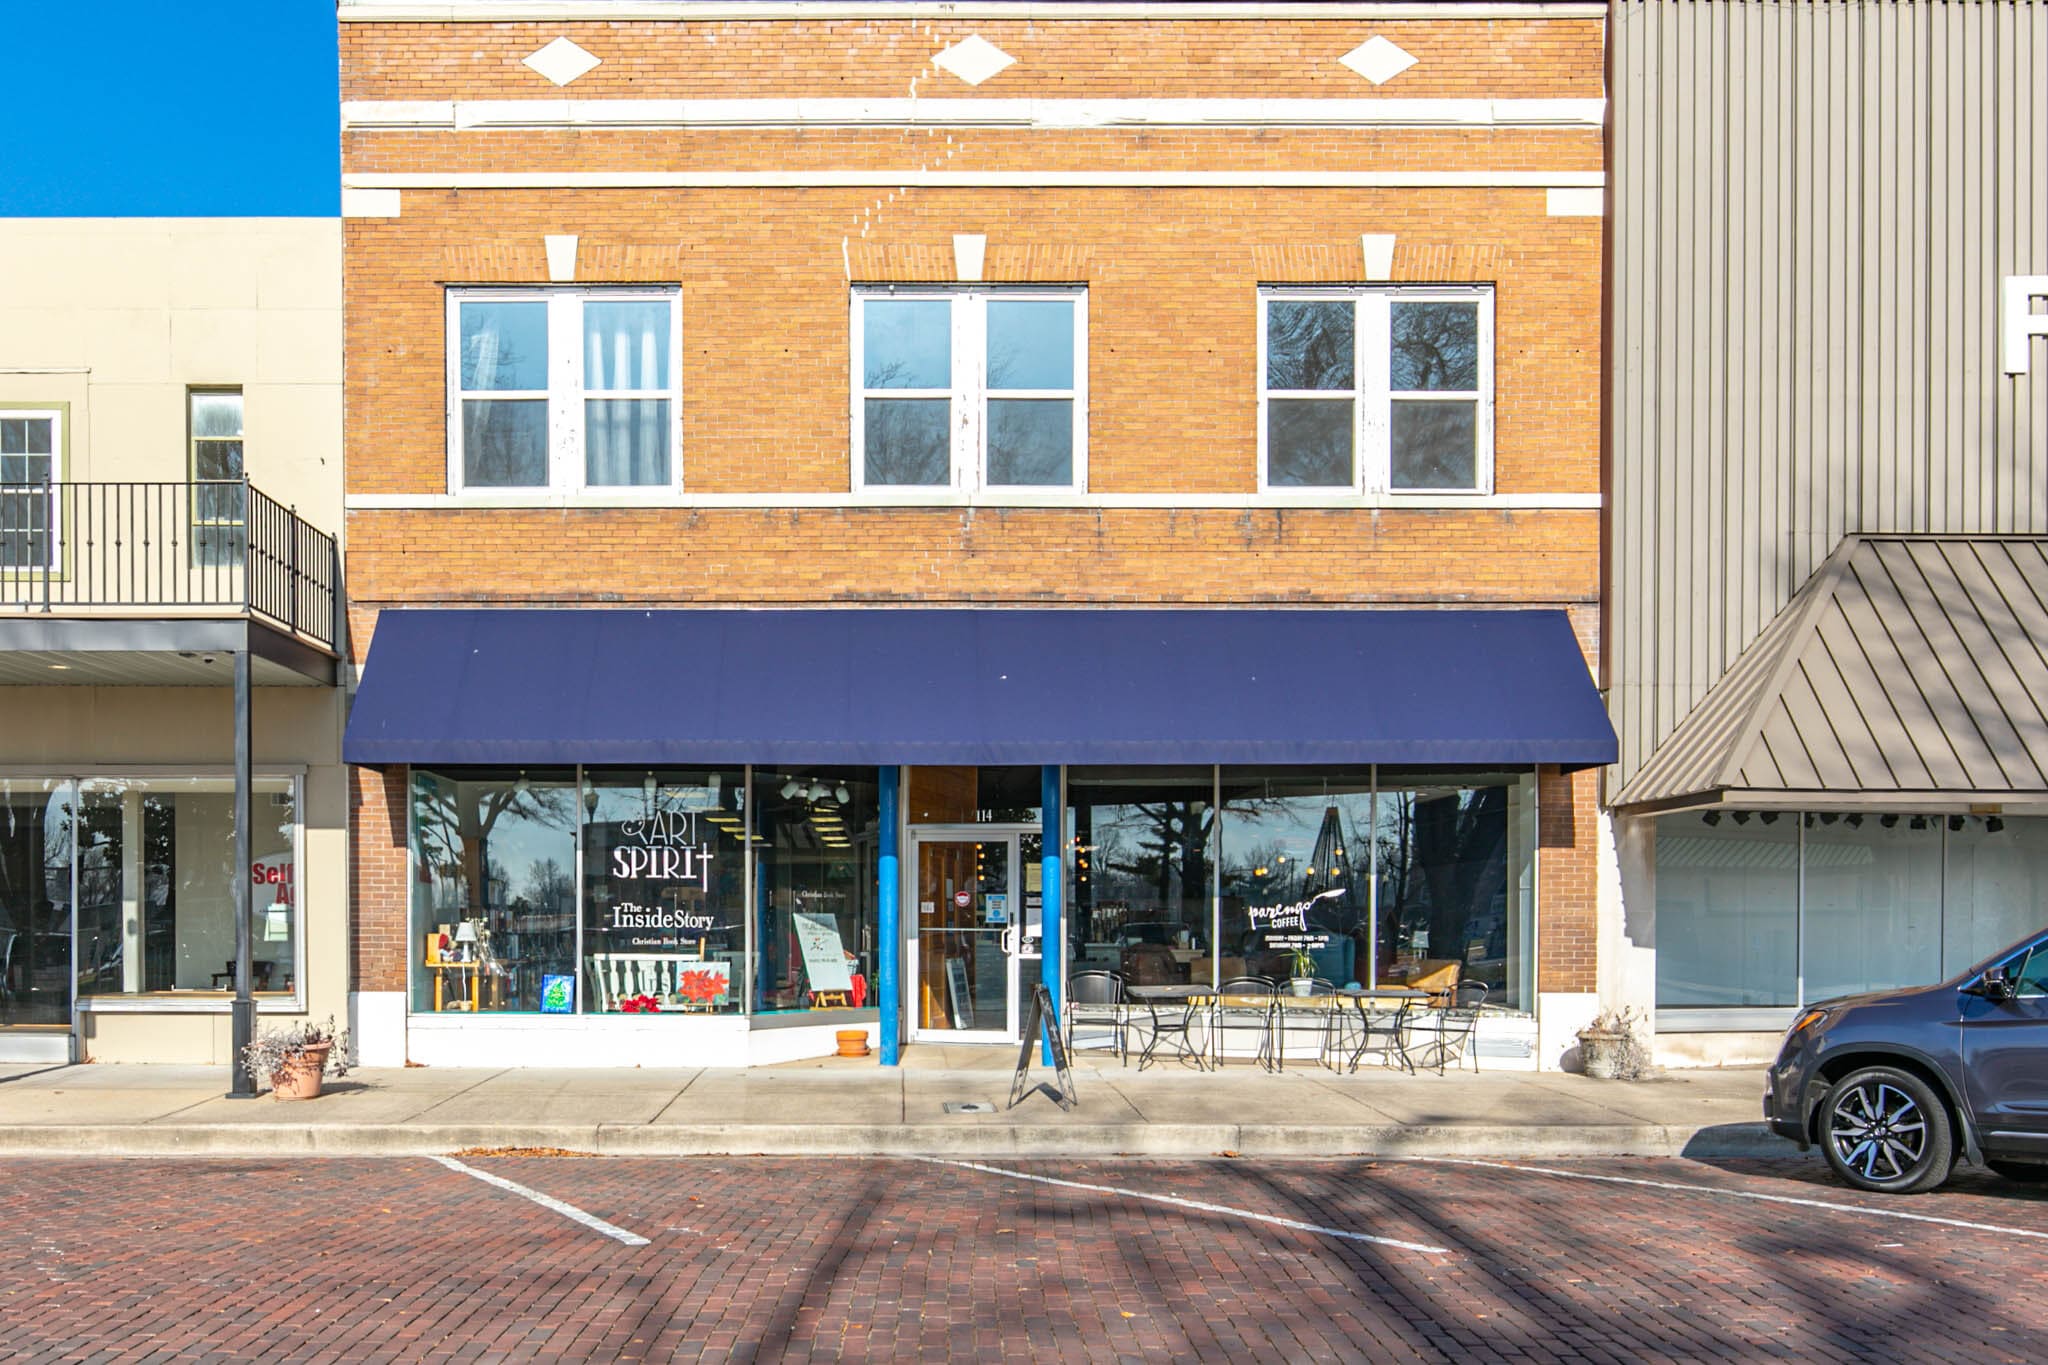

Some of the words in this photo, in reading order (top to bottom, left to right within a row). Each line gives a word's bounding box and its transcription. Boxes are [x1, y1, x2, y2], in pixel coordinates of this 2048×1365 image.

[976, 808, 993, 822] 114
[650, 810, 702, 845] ART
[621, 902, 643, 913] The
[1271, 916, 1299, 929] COFFEE
[632, 937, 661, 945] Christian
